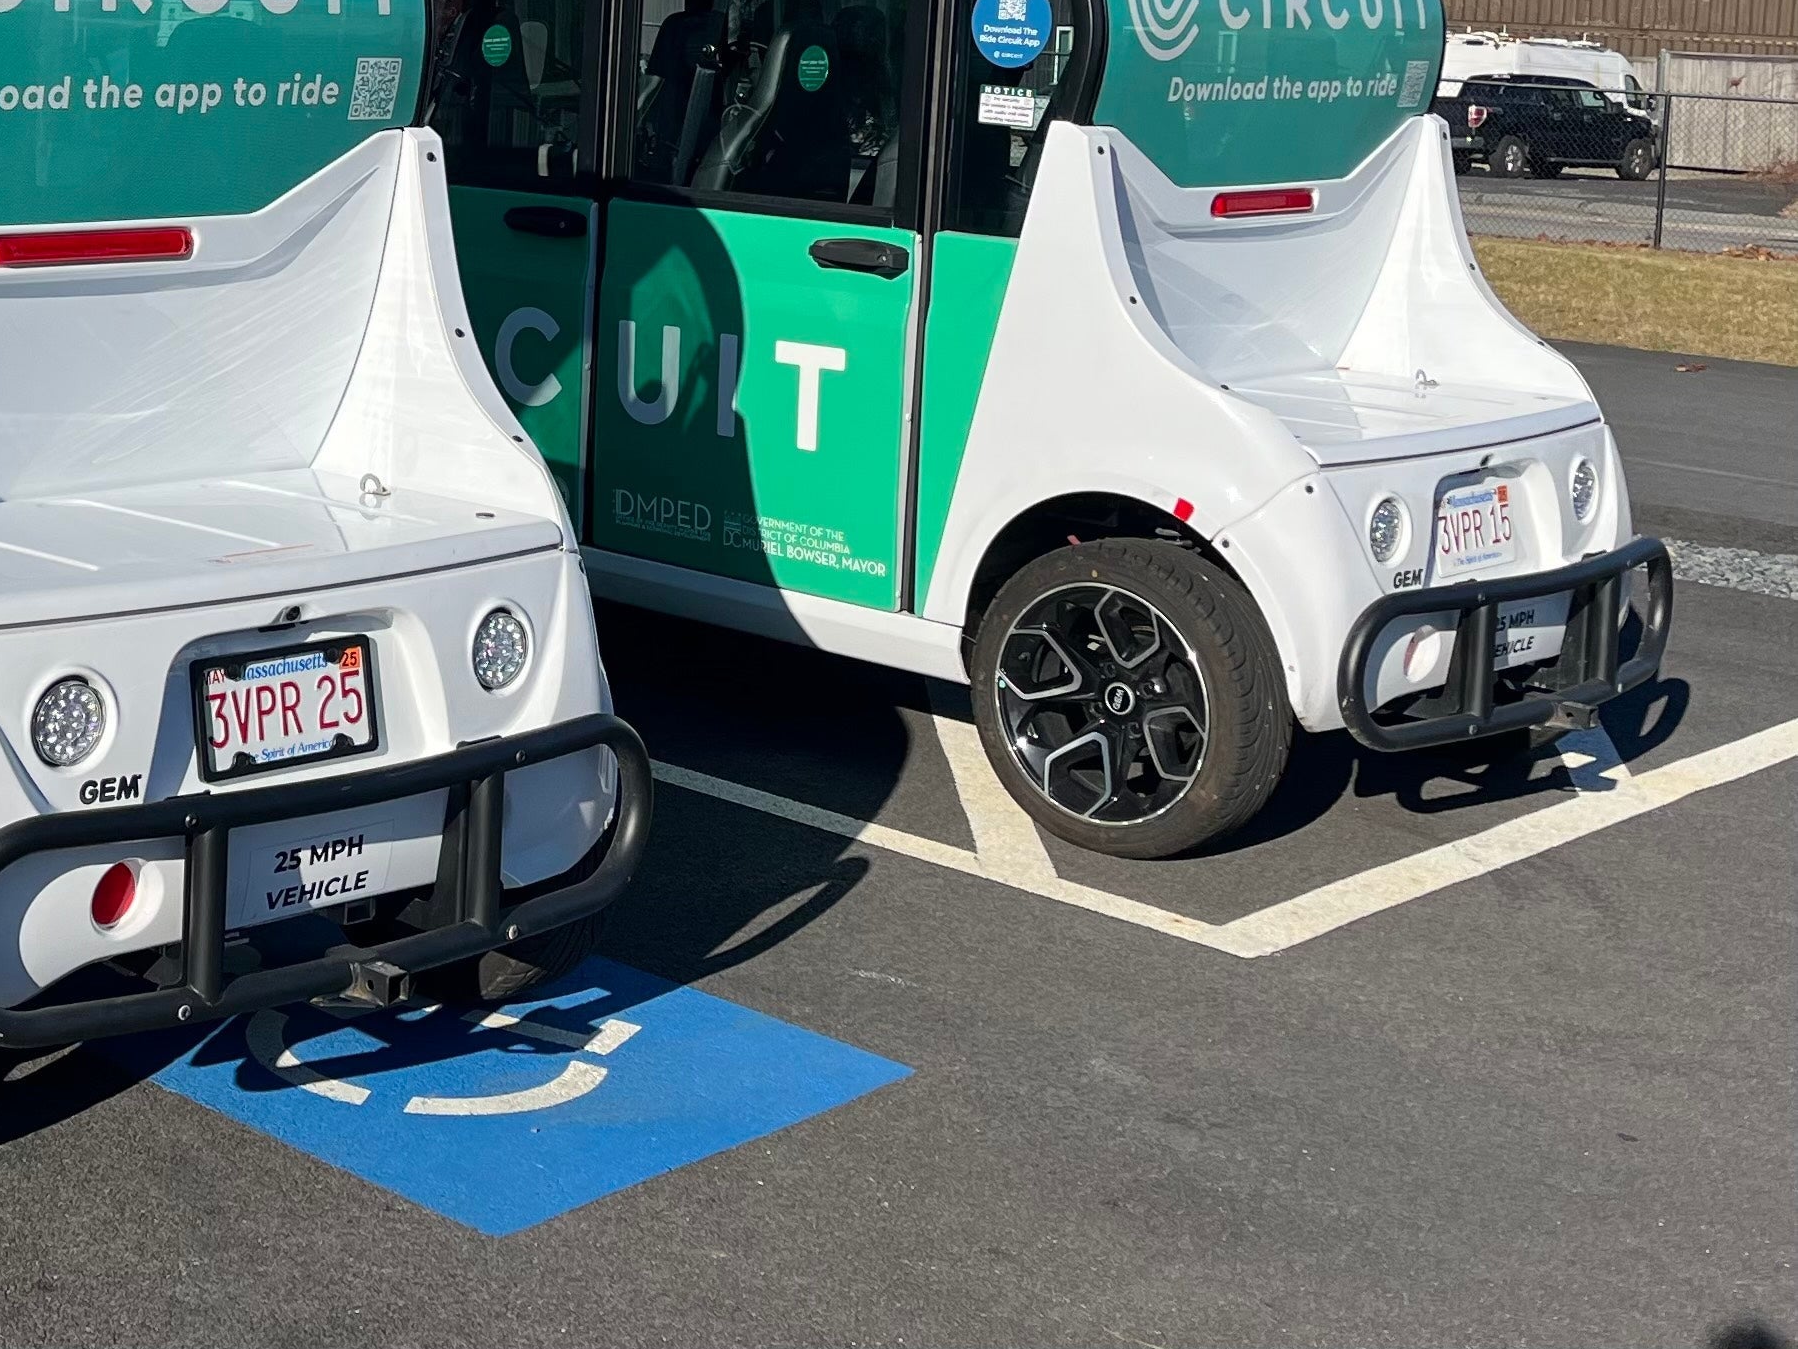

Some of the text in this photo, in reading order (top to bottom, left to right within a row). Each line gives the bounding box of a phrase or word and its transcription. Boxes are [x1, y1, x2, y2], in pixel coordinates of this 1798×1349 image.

[980, 34, 1040, 47] Ride Circuit App
[983, 24, 1038, 36] Download The
[83, 75, 143, 109] the
[156, 82, 222, 115] app
[232, 78, 266, 107] to
[276, 73, 340, 106] ride
[984, 86, 1033, 97] NOTICE
[1168, 73, 1398, 103] Download the app to ride
[496, 306, 846, 452] CUIT
[613, 489, 712, 531] DMPED
[742, 514, 844, 542] GOVERNMENT OF THE
[1438, 504, 1512, 554] 3VPR 15
[742, 537, 886, 577] MURIEL BOWSER, MAYOR
[784, 532, 797, 545] OF
[799, 536, 850, 555] COLUMBIA
[1393, 568, 1423, 589] GEM
[1509, 609, 1535, 628] MPH
[342, 652, 358, 667] 25
[1493, 636, 1534, 658] EHICLE
[205, 670, 363, 748] 3VPR 25
[260, 746, 284, 760] Spirit
[286, 745, 296, 758] of
[79, 773, 142, 805] GEM
[273, 833, 365, 874] 25 MPH
[265, 869, 369, 910] VEHICLE
